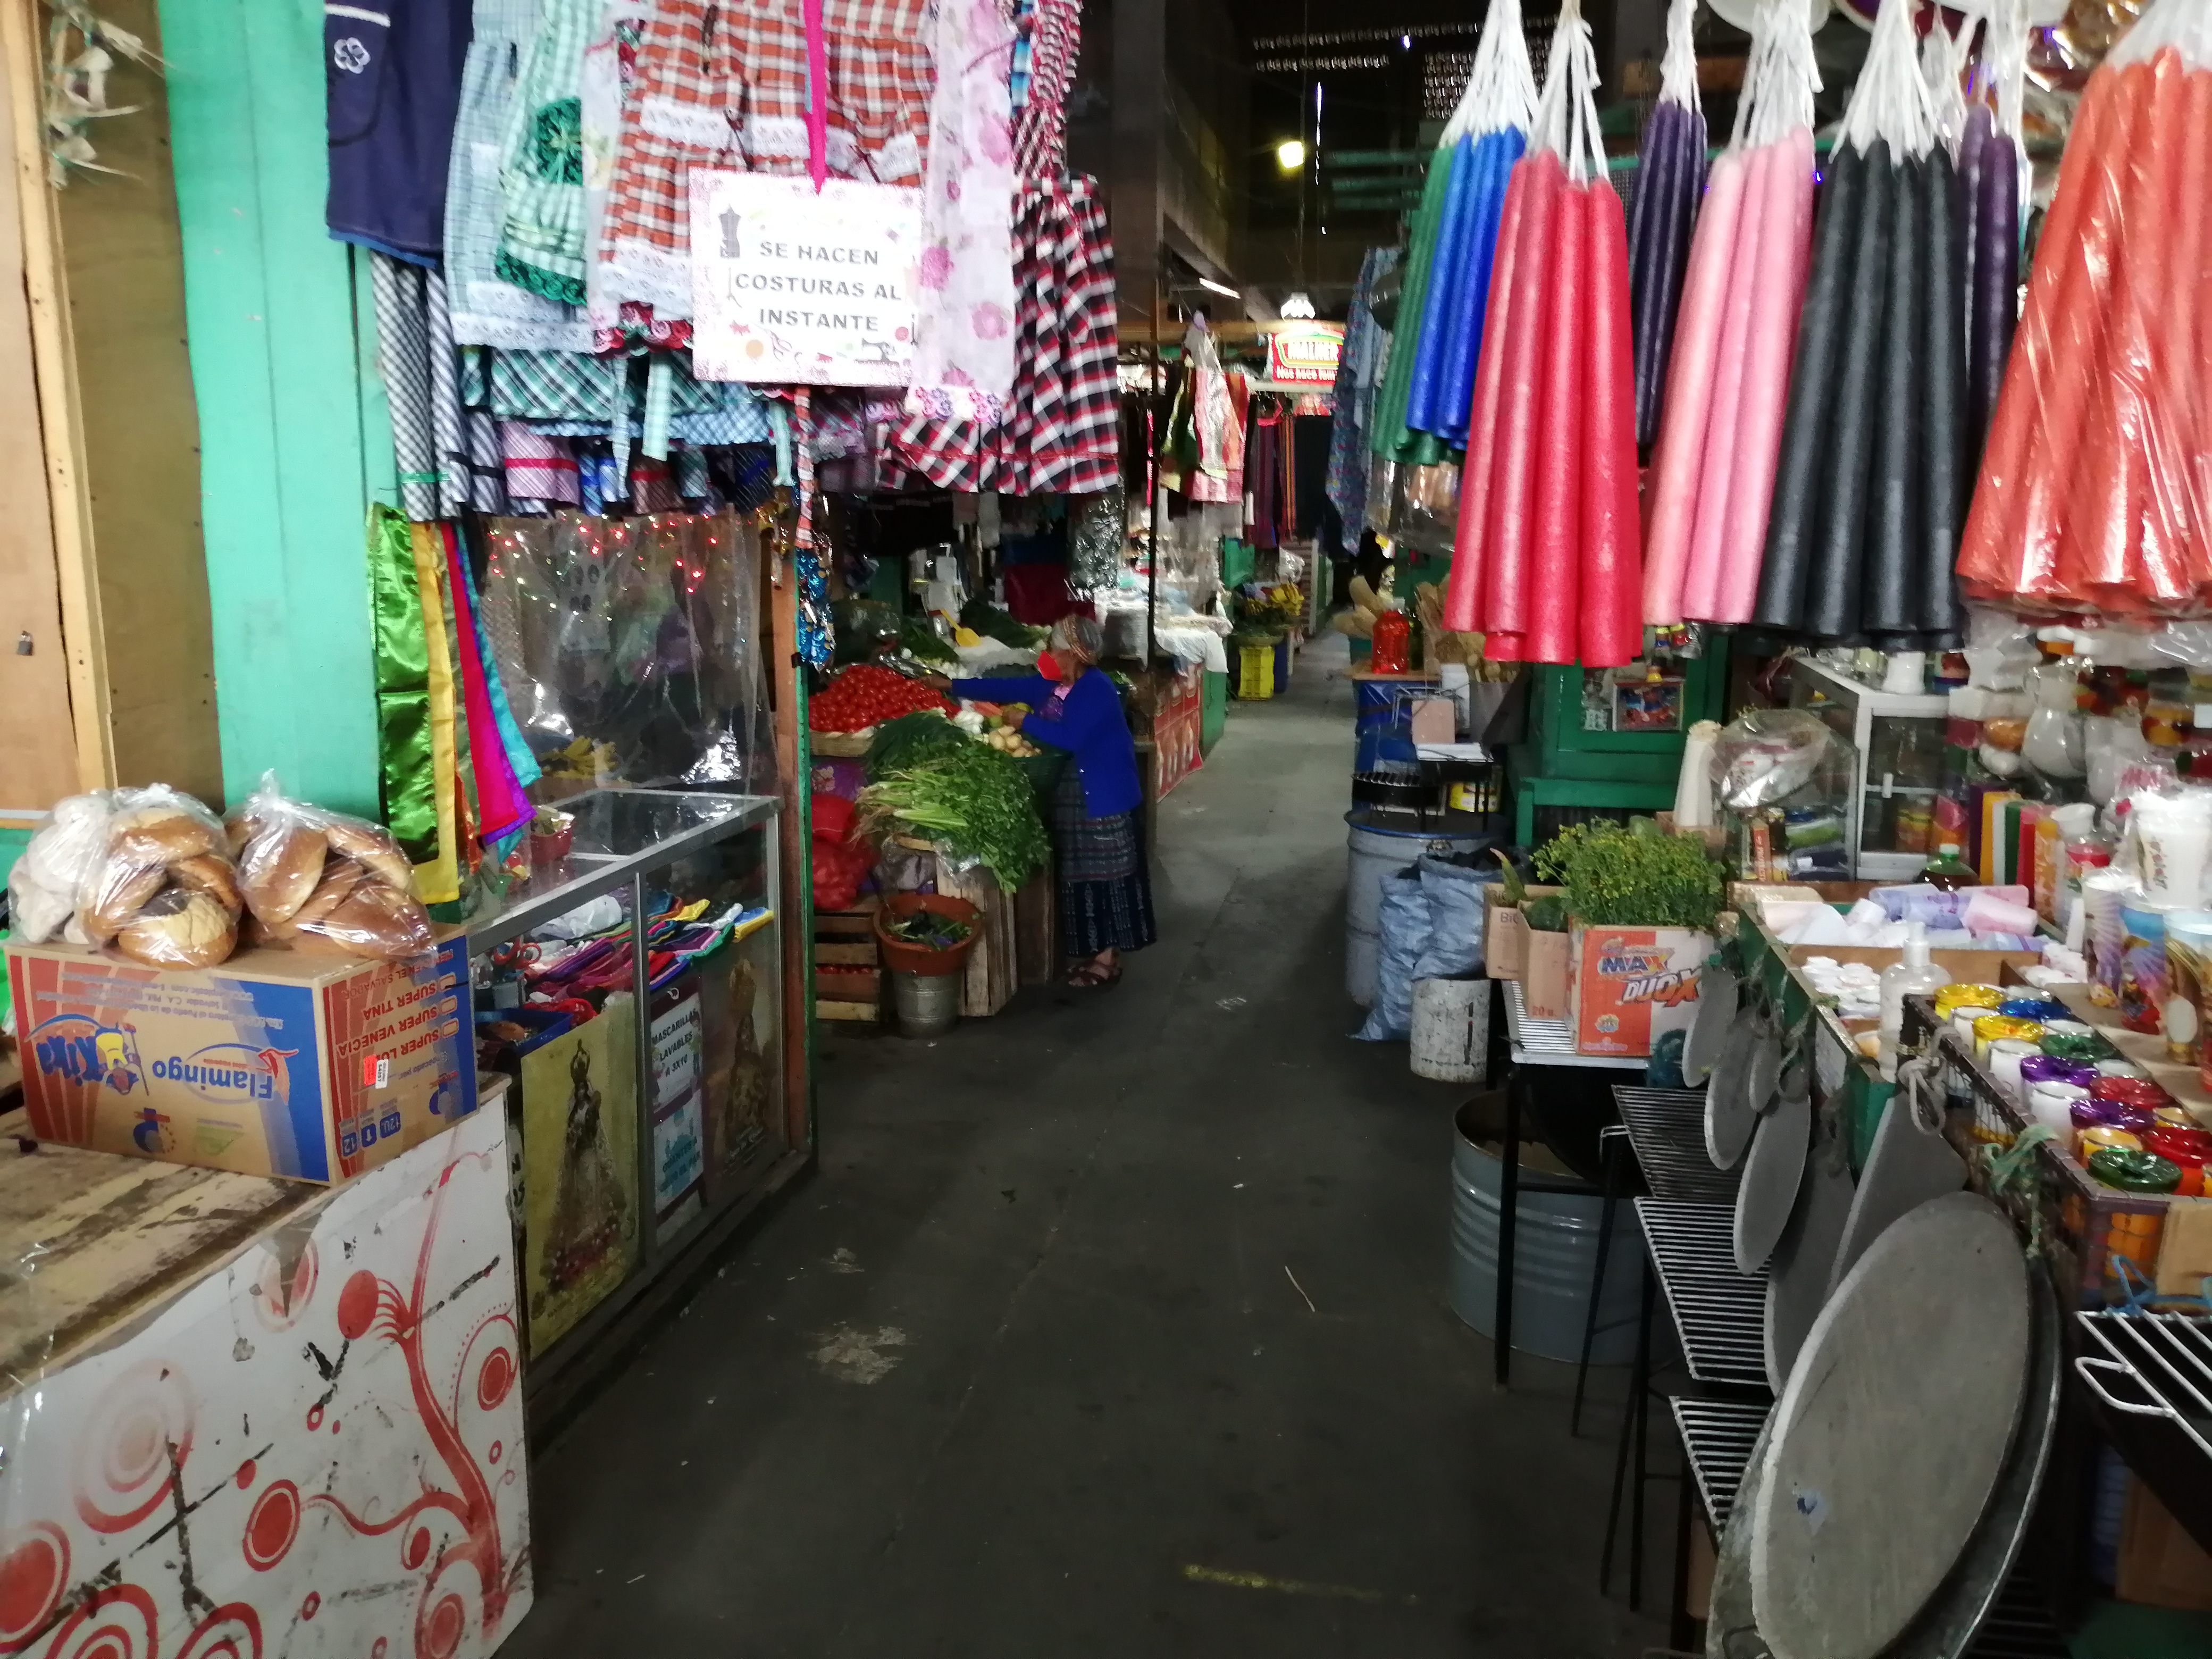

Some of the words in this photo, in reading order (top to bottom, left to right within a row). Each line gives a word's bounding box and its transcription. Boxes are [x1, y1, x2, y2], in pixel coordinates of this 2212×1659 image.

[760, 242, 788, 259] SE
[799, 245, 879, 265] HACEN
[735, 273, 865, 298] COSTURAS
[874, 284, 901, 301] AL
[759, 309, 879, 331] INSTANTE
[397, 983, 436, 1008] SUPER
[363, 1000, 393, 1020] TINA
[399, 1006, 438, 1030] SUPER
[338, 1026, 395, 1057] VENECIA
[400, 1029, 439, 1055] SUPER
[660, 1030, 692, 1062] LAVABLES
[152, 1056, 272, 1103] Flamingo
